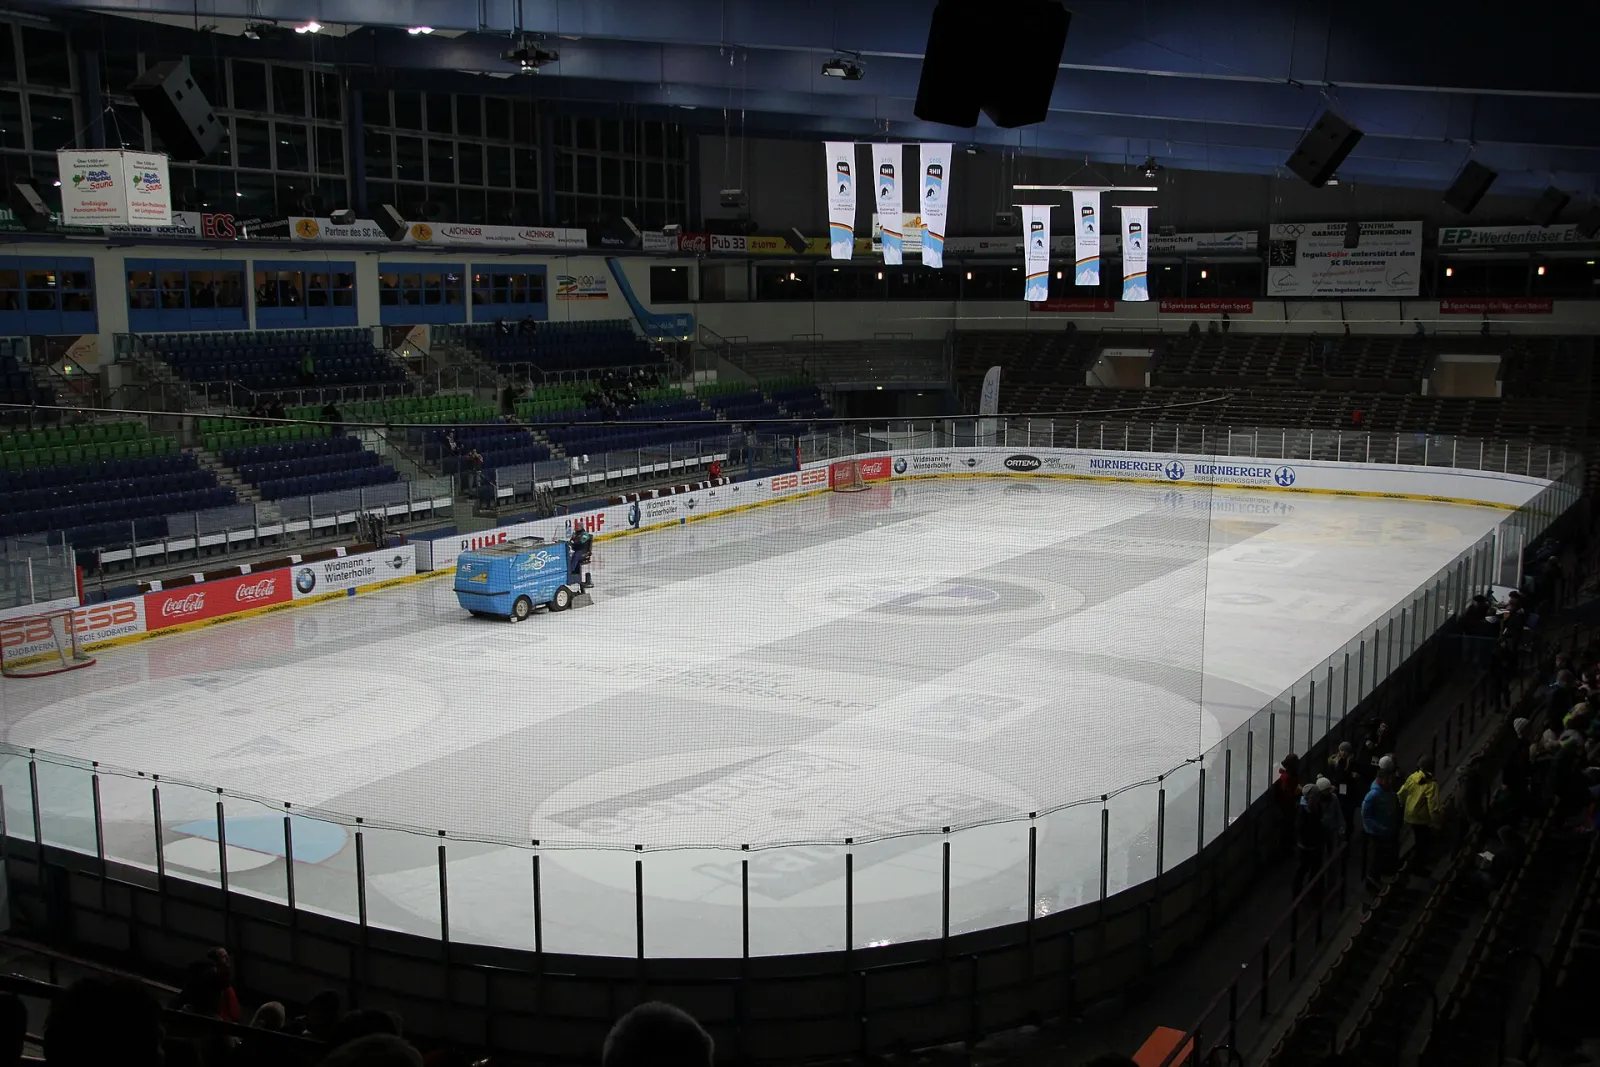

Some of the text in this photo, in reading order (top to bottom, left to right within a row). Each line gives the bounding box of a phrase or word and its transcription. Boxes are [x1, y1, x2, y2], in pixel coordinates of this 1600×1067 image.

[90, 180, 113, 190] Sauna
[145, 184, 162, 192] Sauna
[202, 213, 237, 240] ECS
[325, 226, 348, 236] Partner
[350, 228, 362, 236] des
[362, 228, 370, 236] SC
[449, 228, 482, 236] AICHINGER
[526, 230, 556, 239] AICHINGER
[712, 236, 746, 249] Pub 33
[1442, 229, 1477, 244] EP:
[1479, 230, 1562, 243] Werdenfelser
[758, 240, 776, 248] LOTTO
[1006, 459, 1040, 467] ORTEMA
[1090, 458, 1163, 472] NÜRNBERGER
[802, 470, 827, 485] ESB
[1194, 464, 1272, 478] NÜRNBERGER
[772, 474, 798, 492] ESB
[1193, 476, 1272, 485] VERSICHERUNGSGRUPPE
[325, 558, 364, 572] Widmann
[325, 567, 376, 583] Winterholler
[162, 578, 276, 617] Coca-Cola Coca-Cola
[64, 602, 138, 634] ESB
